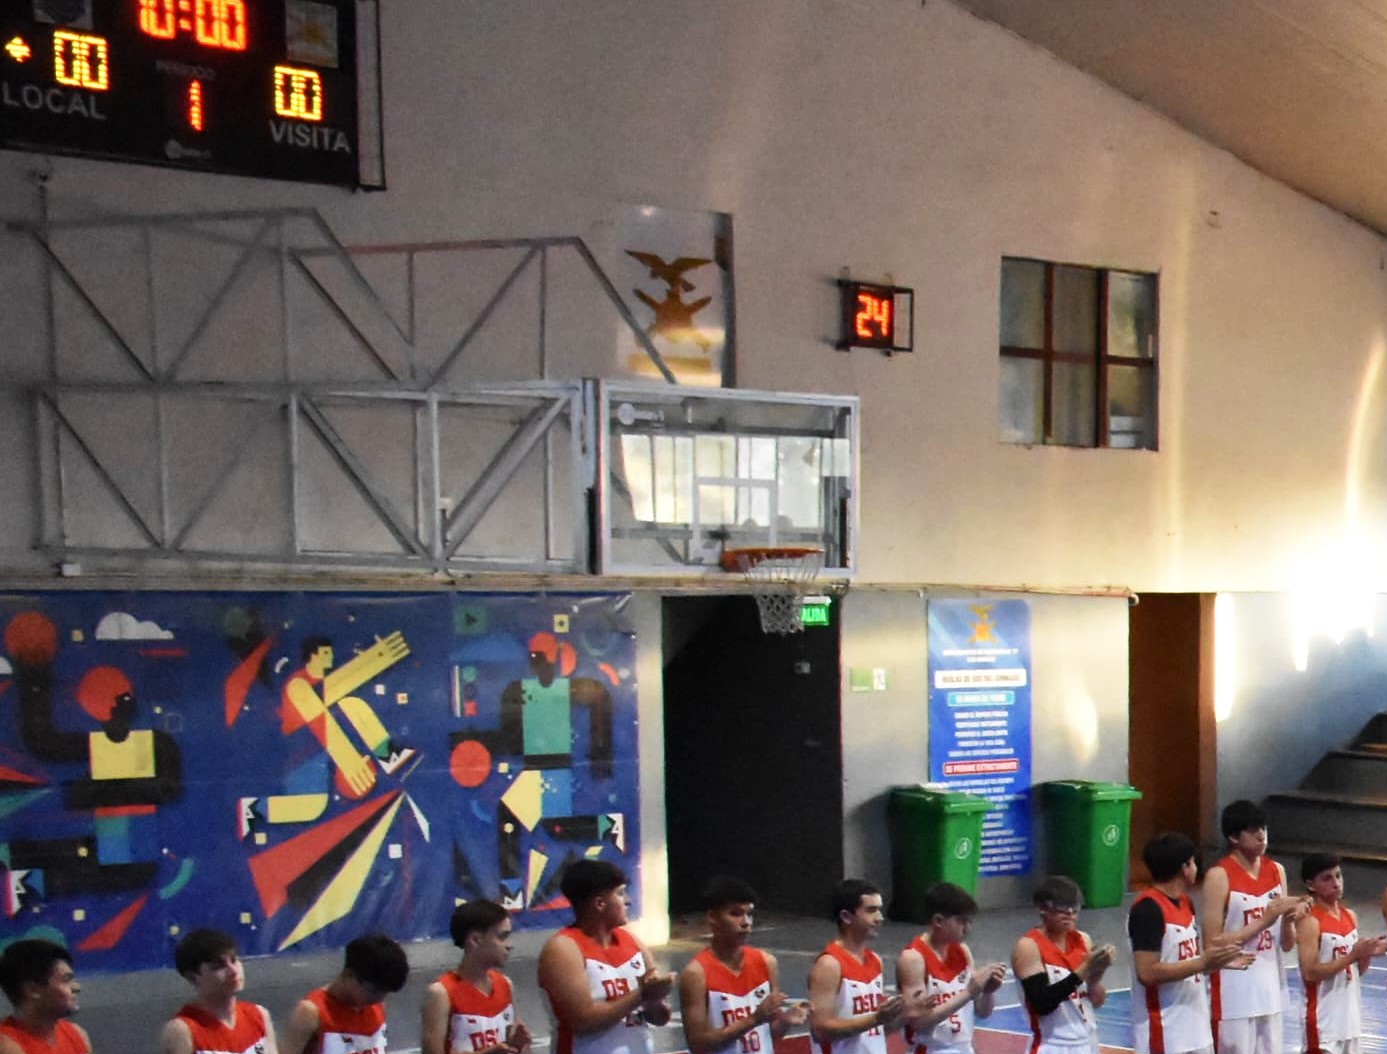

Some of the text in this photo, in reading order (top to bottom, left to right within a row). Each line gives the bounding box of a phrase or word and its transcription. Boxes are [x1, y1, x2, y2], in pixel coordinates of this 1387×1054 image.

[54, 30, 109, 90] 00
[2, 81, 107, 120] LOCAL
[189, 79, 203, 131] 1
[274, 65, 322, 120] 00
[269, 119, 352, 154] VISITA
[855, 292, 890, 338] 24
[800, 607, 827, 623] ALIDA
[740, 1030, 761, 1054] 10
